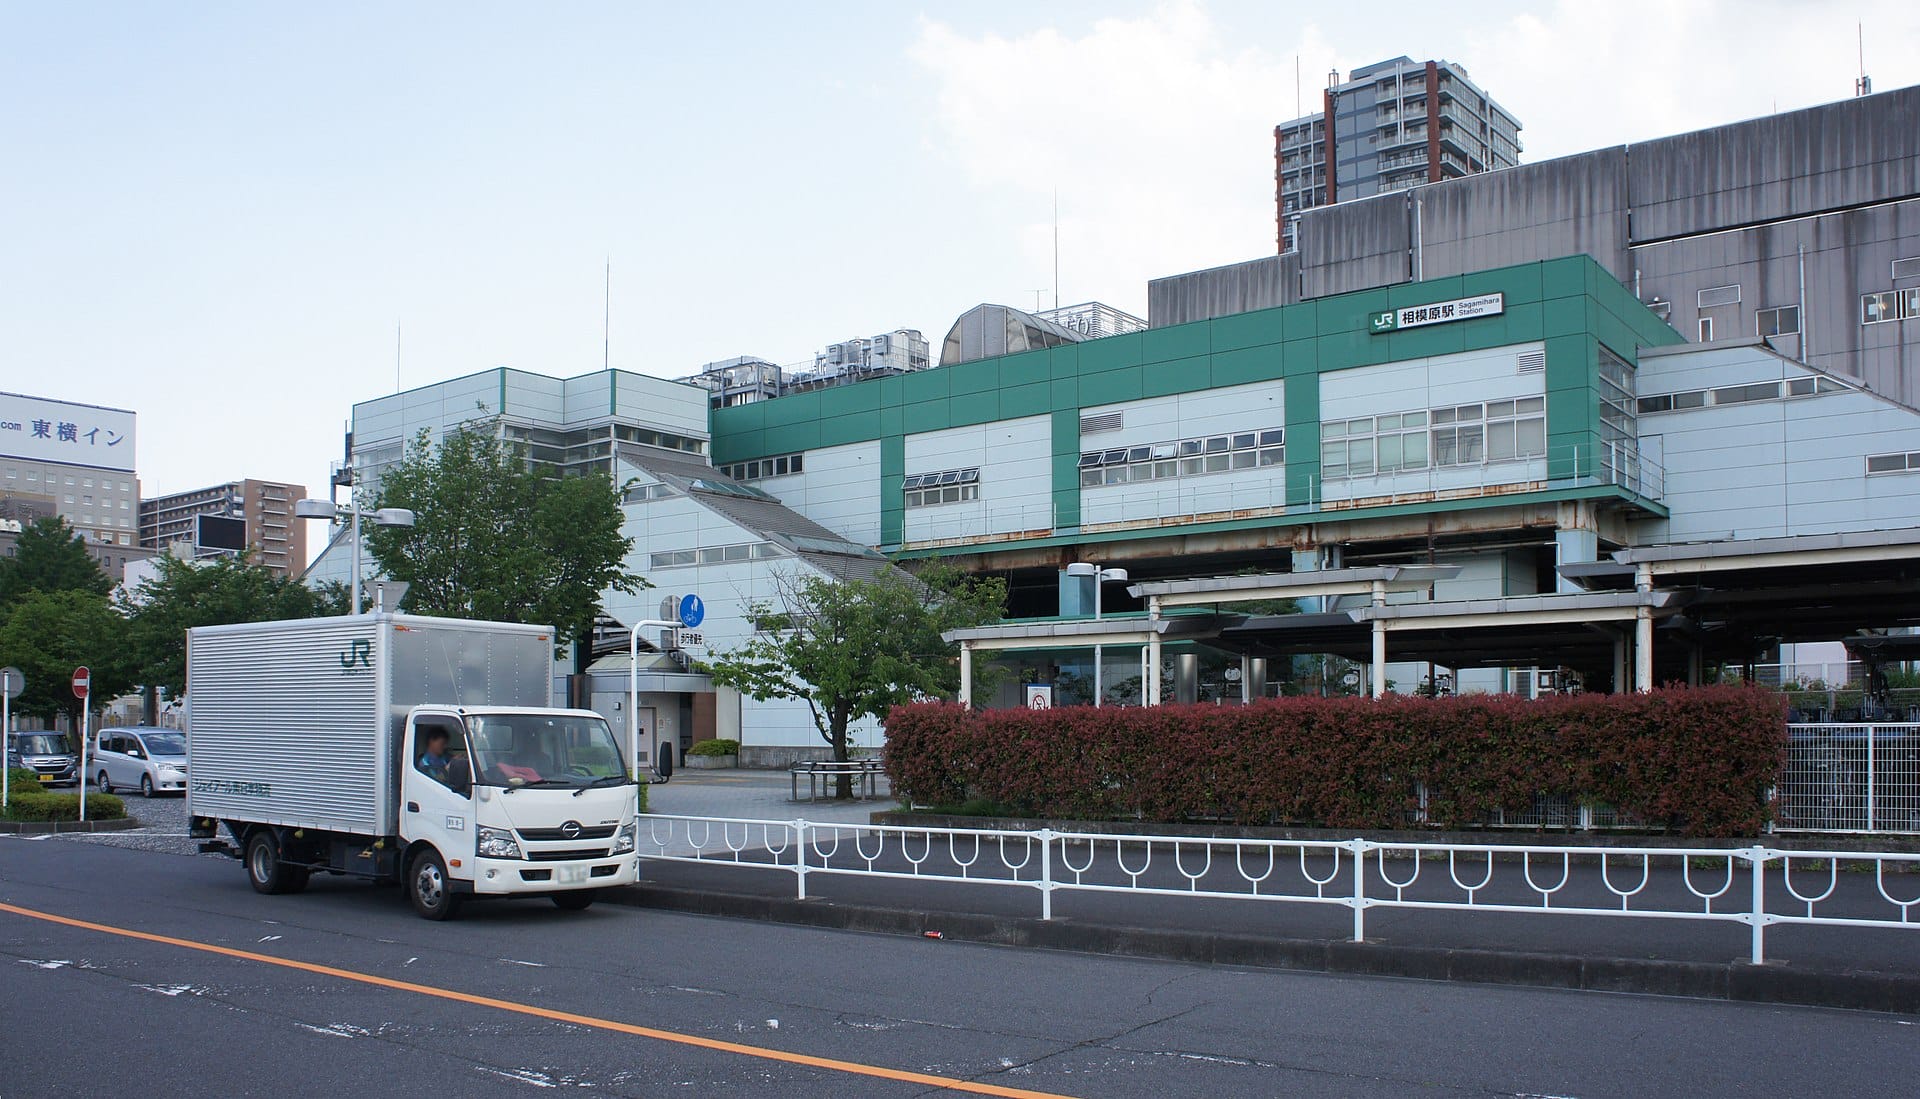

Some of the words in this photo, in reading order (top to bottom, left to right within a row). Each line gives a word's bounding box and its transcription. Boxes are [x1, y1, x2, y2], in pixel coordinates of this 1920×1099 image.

[1459, 297, 1500, 309] Sagamihara
[1374, 313, 1393, 326] JR
[1402, 305, 1454, 325] 相模原駅
[1459, 307, 1483, 316] Station
[31, 419, 124, 447] 東横イン
[340, 639, 371, 668] JR
